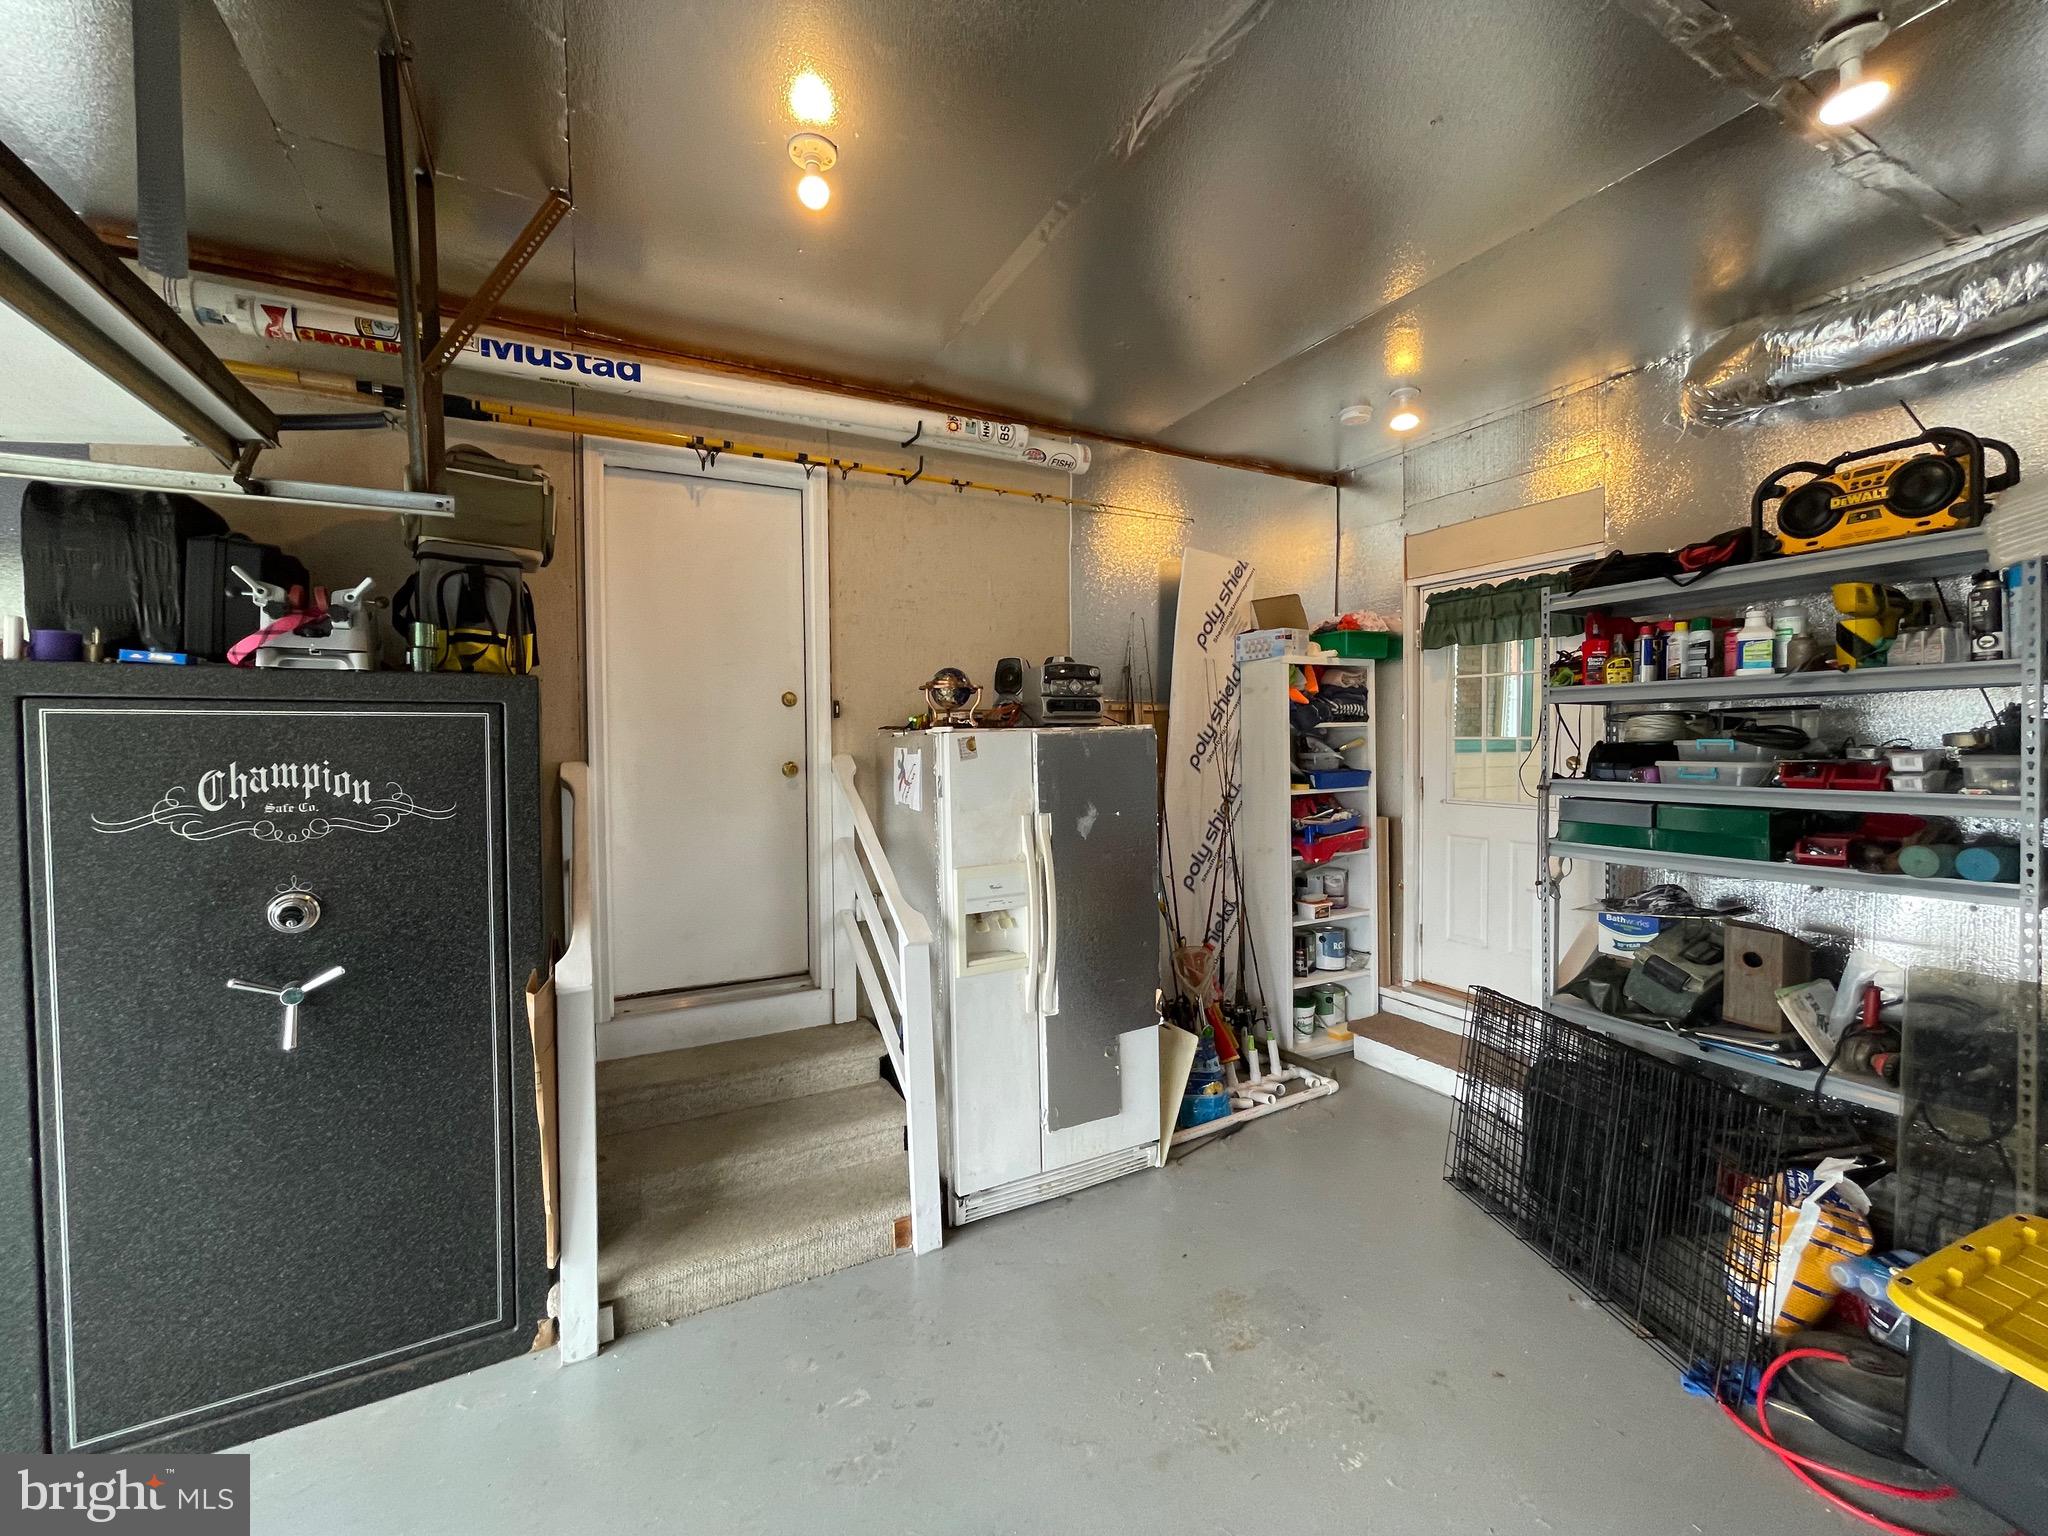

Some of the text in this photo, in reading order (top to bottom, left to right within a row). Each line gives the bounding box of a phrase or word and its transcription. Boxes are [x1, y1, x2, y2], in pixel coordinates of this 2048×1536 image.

[1050, 457, 1075, 469] FISH!
[1197, 602, 1225, 653] poly
[1189, 722, 1218, 775] poly
[197, 760, 372, 812] Champion
[263, 802, 295, 814] Safe
